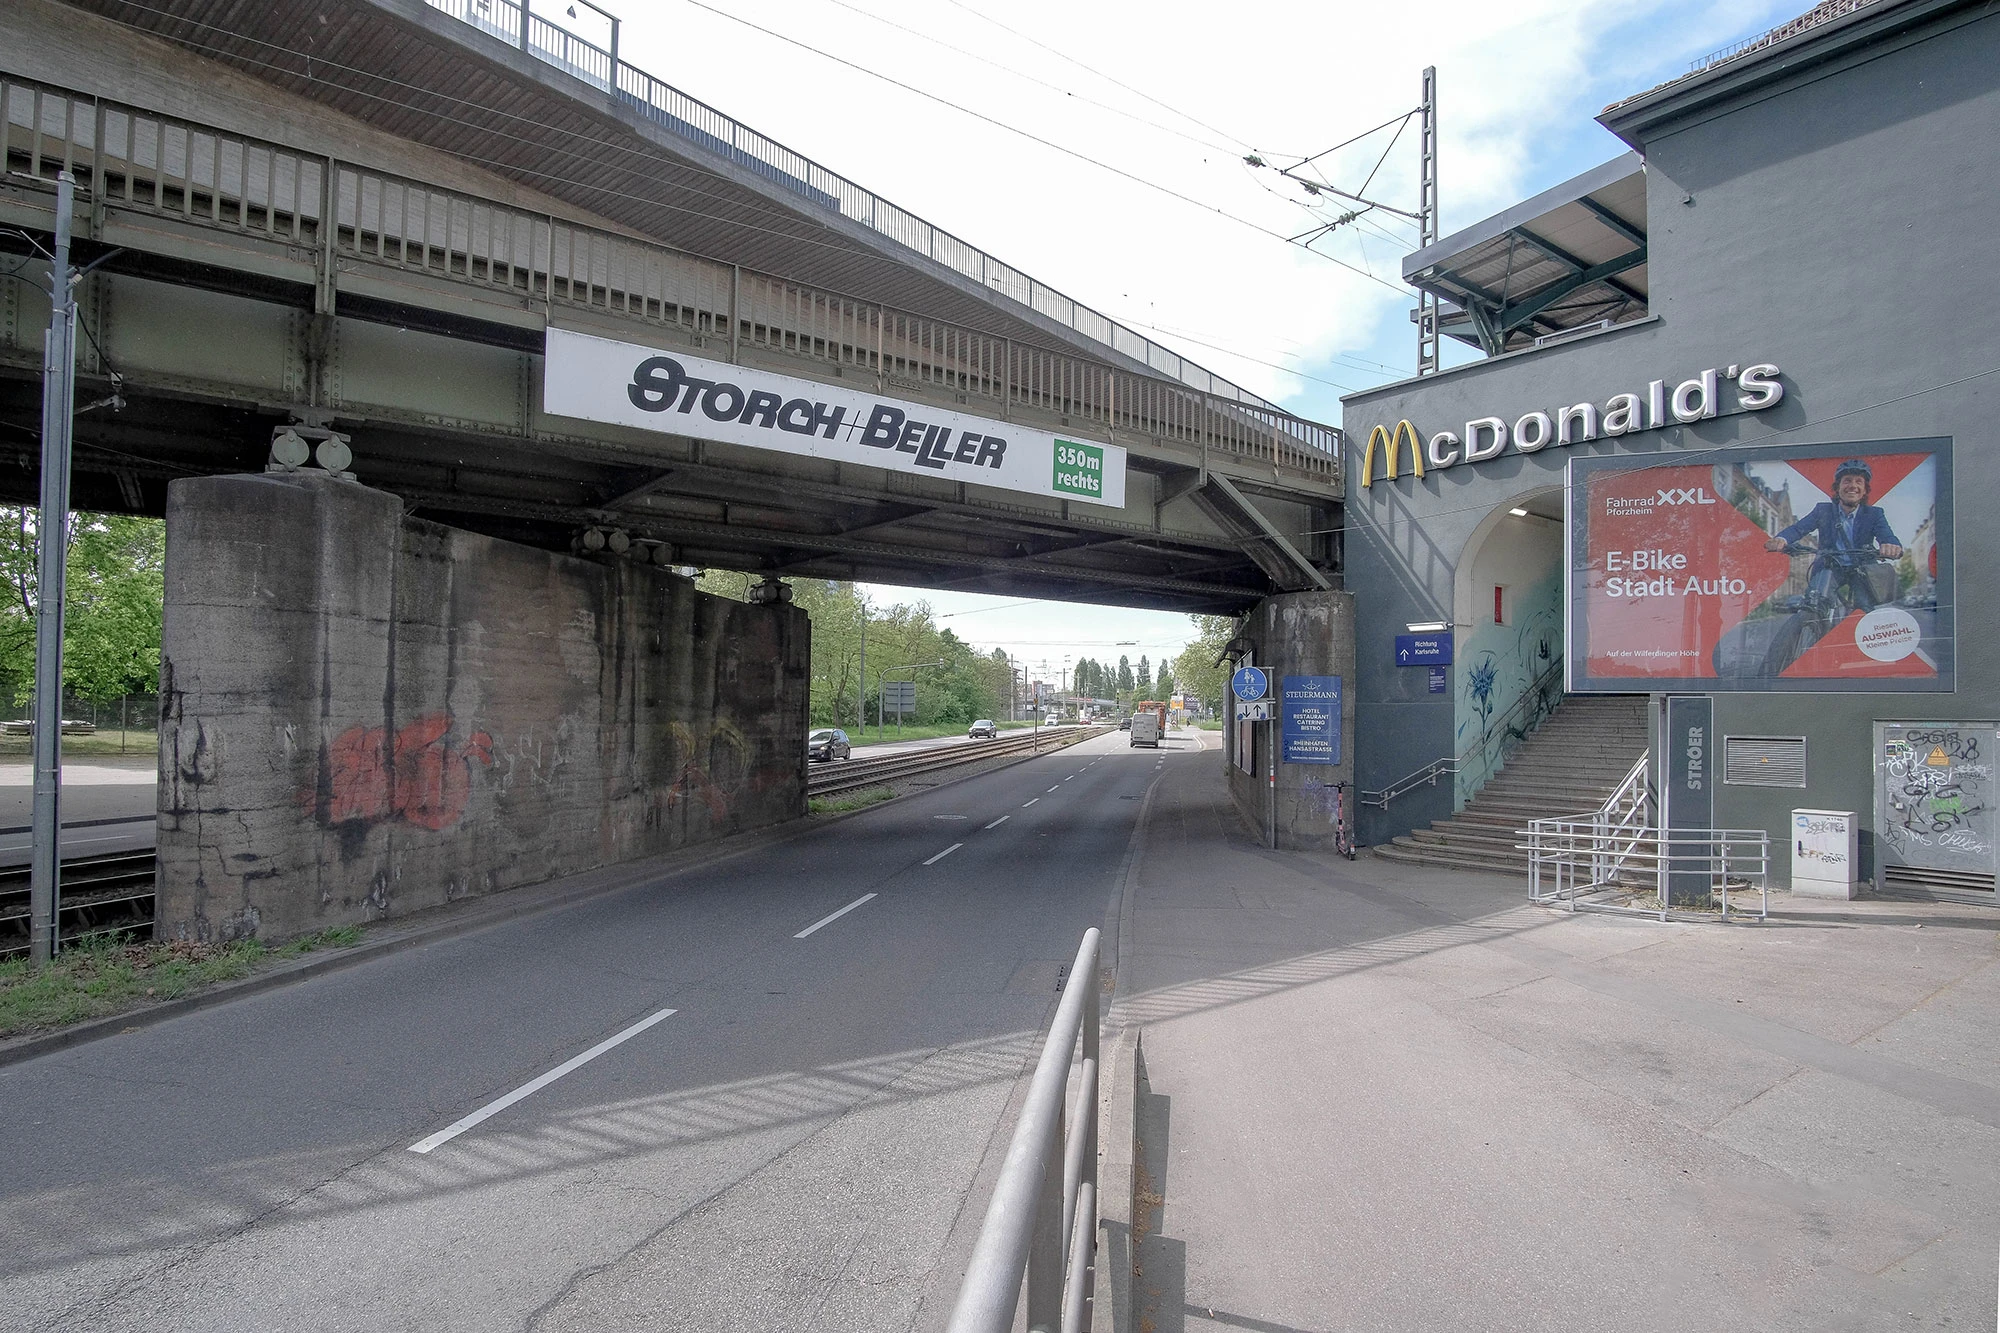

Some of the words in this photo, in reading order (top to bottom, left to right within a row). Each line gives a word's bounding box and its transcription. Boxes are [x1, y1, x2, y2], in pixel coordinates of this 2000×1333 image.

[1362, 363, 1784, 488] McDonald's
[1057, 446, 1100, 470] 350m
[1057, 471, 1099, 491] rechts
[1606, 496, 1655, 508] Fahrrad
[1656, 487, 1716, 506] XXL
[1606, 507, 1653, 516] Pforzheim
[1606, 549, 1688, 572] E-Bike
[1605, 576, 1675, 598] Stadt
[1682, 575, 1752, 596] Auto.
[1862, 627, 1915, 642] AUSWAHL.
[1873, 622, 1899, 631] Riesen
[1634, 650, 1678, 659] Wilferdinger
[1866, 640, 1889, 649] Kleine
[1285, 691, 1338, 699] STEUERMANN
[1686, 726, 1703, 790] STRÖER
